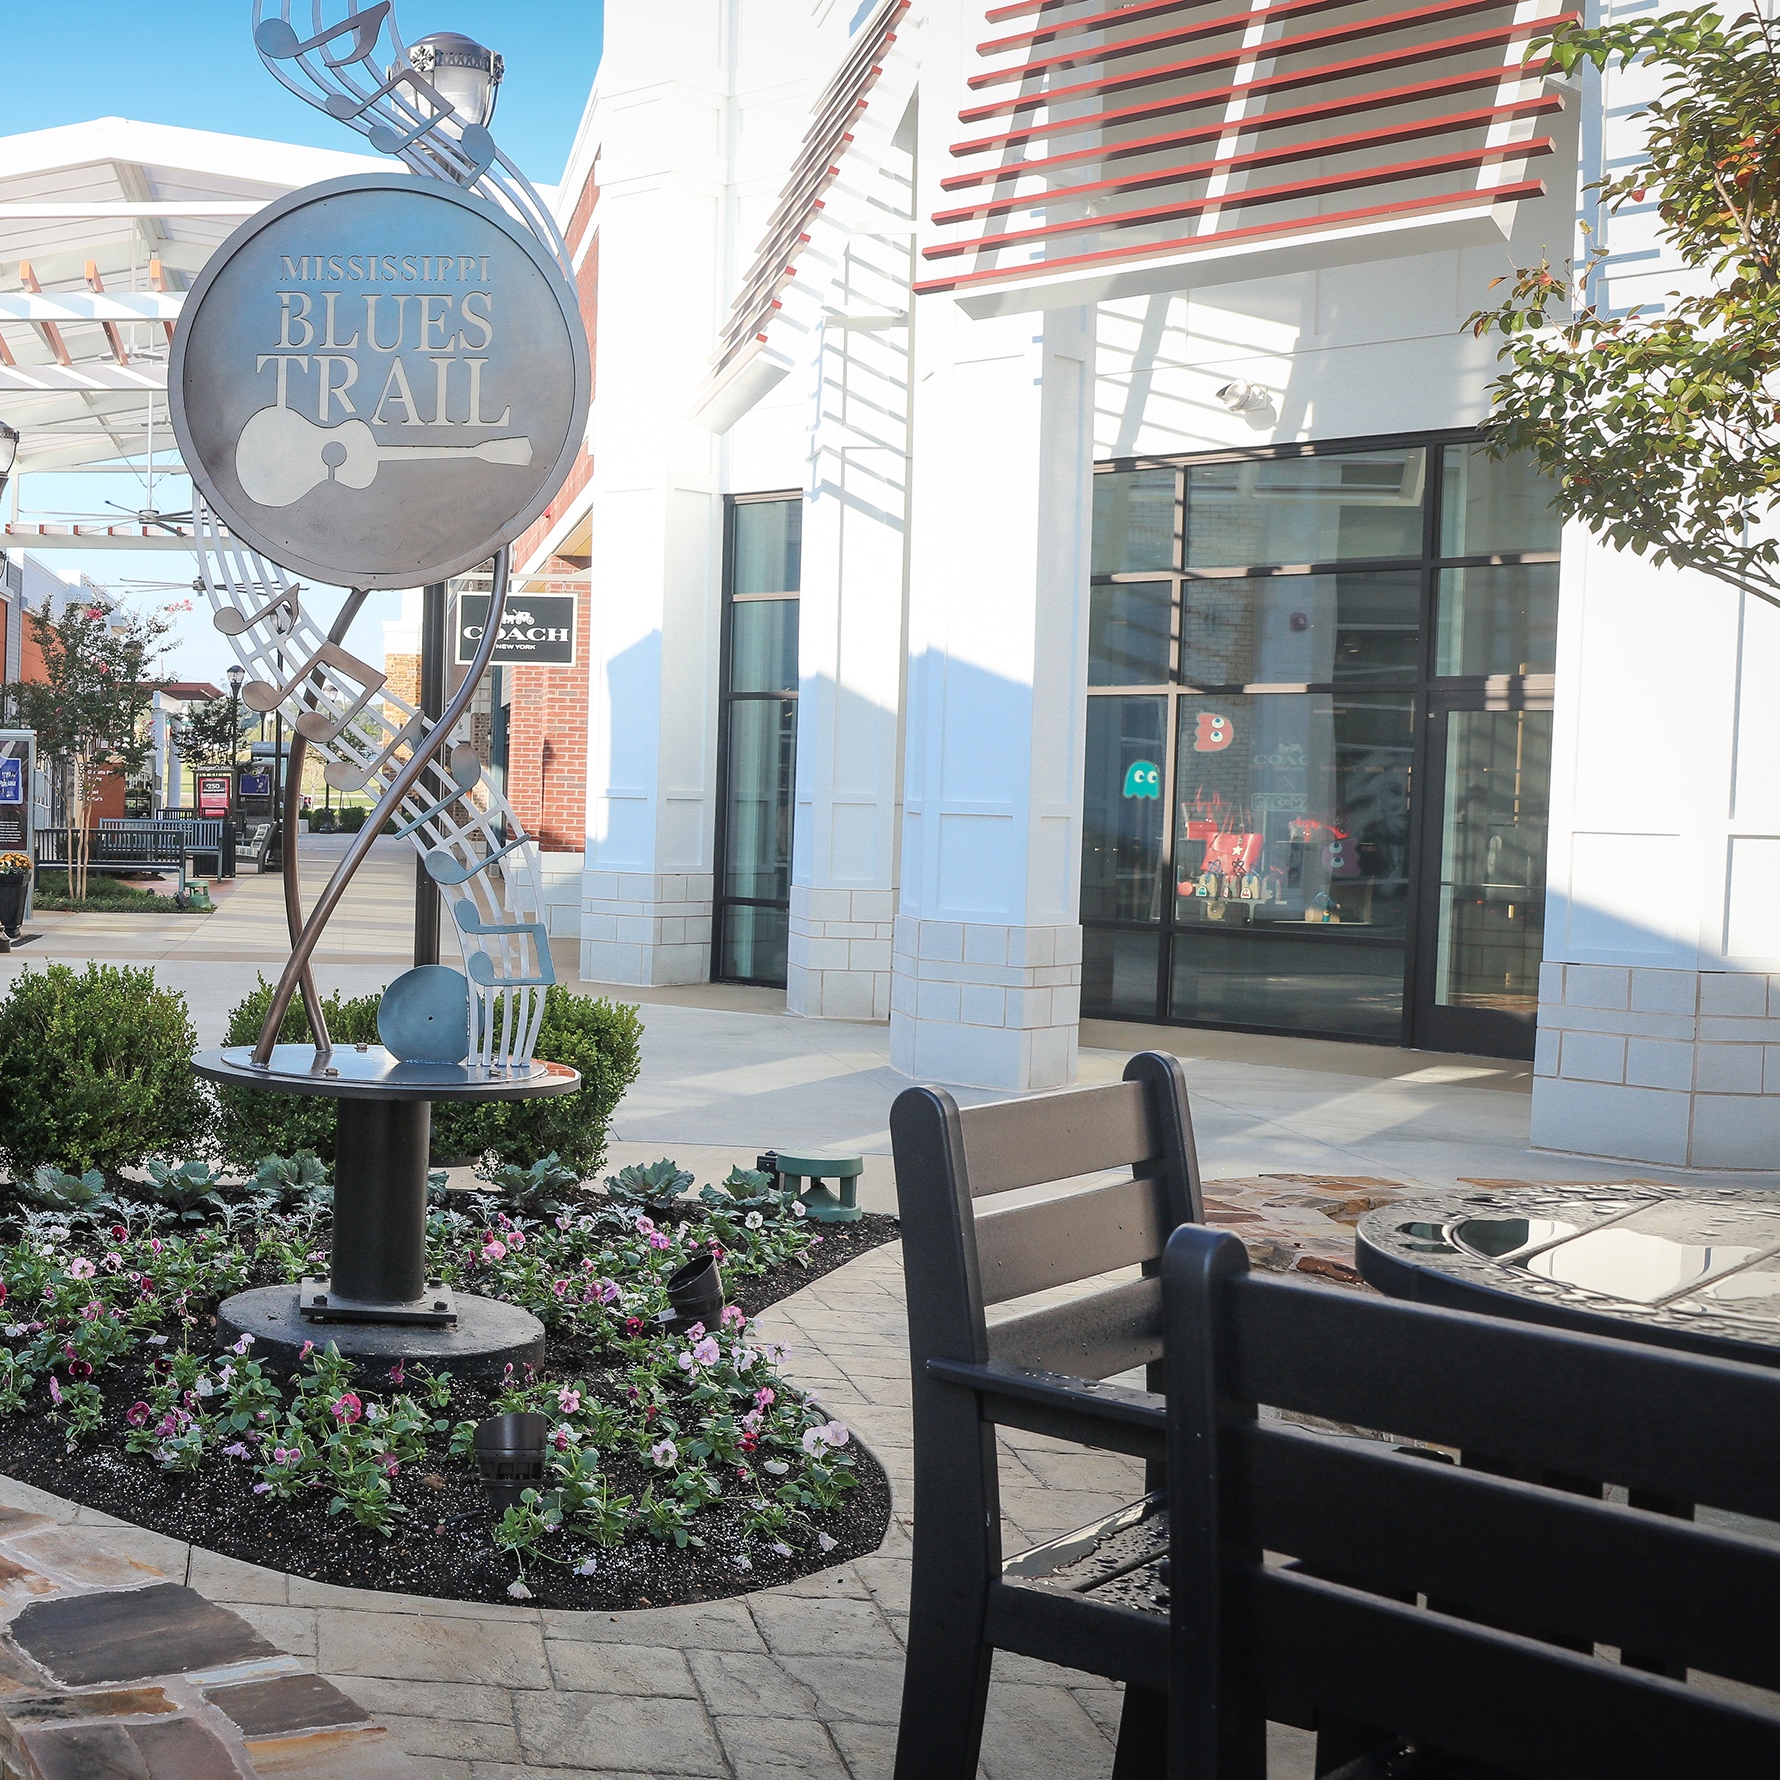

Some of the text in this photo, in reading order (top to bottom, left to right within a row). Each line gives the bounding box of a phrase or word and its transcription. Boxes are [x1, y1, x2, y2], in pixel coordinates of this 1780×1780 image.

[278, 254, 491, 283] MISSISSIPPI
[273, 291, 494, 352] BLUES
[256, 354, 511, 427] TRAIL
[1253, 755, 1310, 765] COAC
